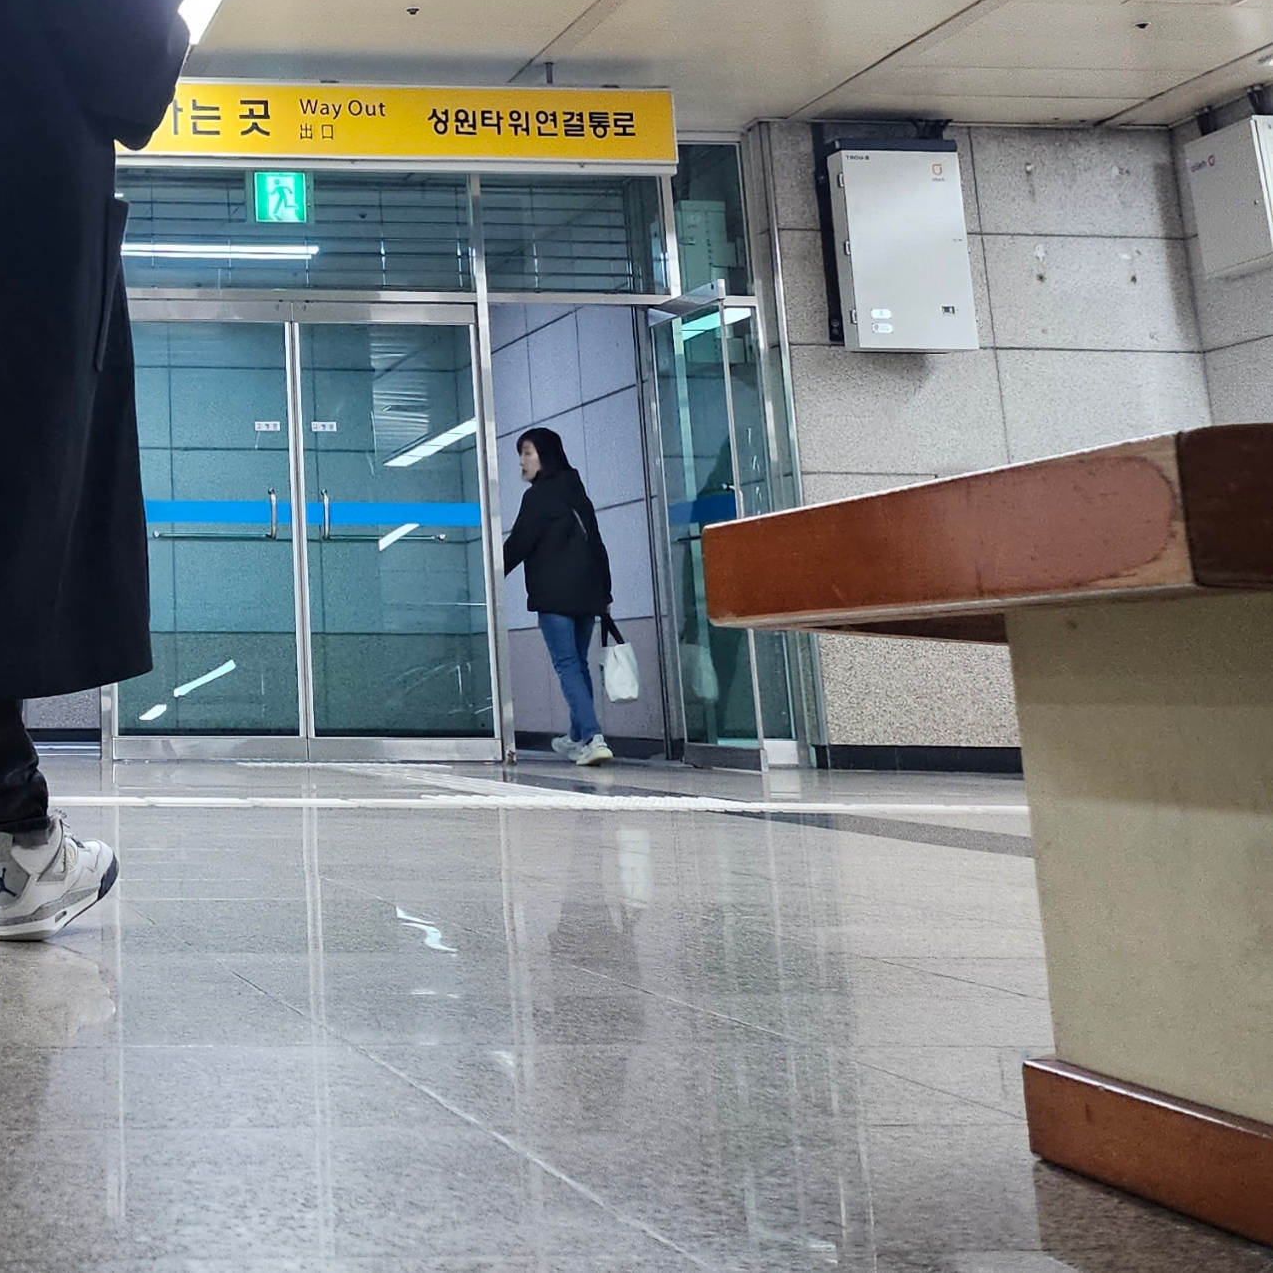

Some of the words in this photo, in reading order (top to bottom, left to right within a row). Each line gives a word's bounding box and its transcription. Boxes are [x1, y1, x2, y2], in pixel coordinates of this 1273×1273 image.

[239, 99, 271, 137] 곳
[299, 98, 342, 120] Way
[347, 99, 386, 117] Out
[299, 123, 334, 140] 出口
[427, 107, 636, 139] 성원타워연결통로
